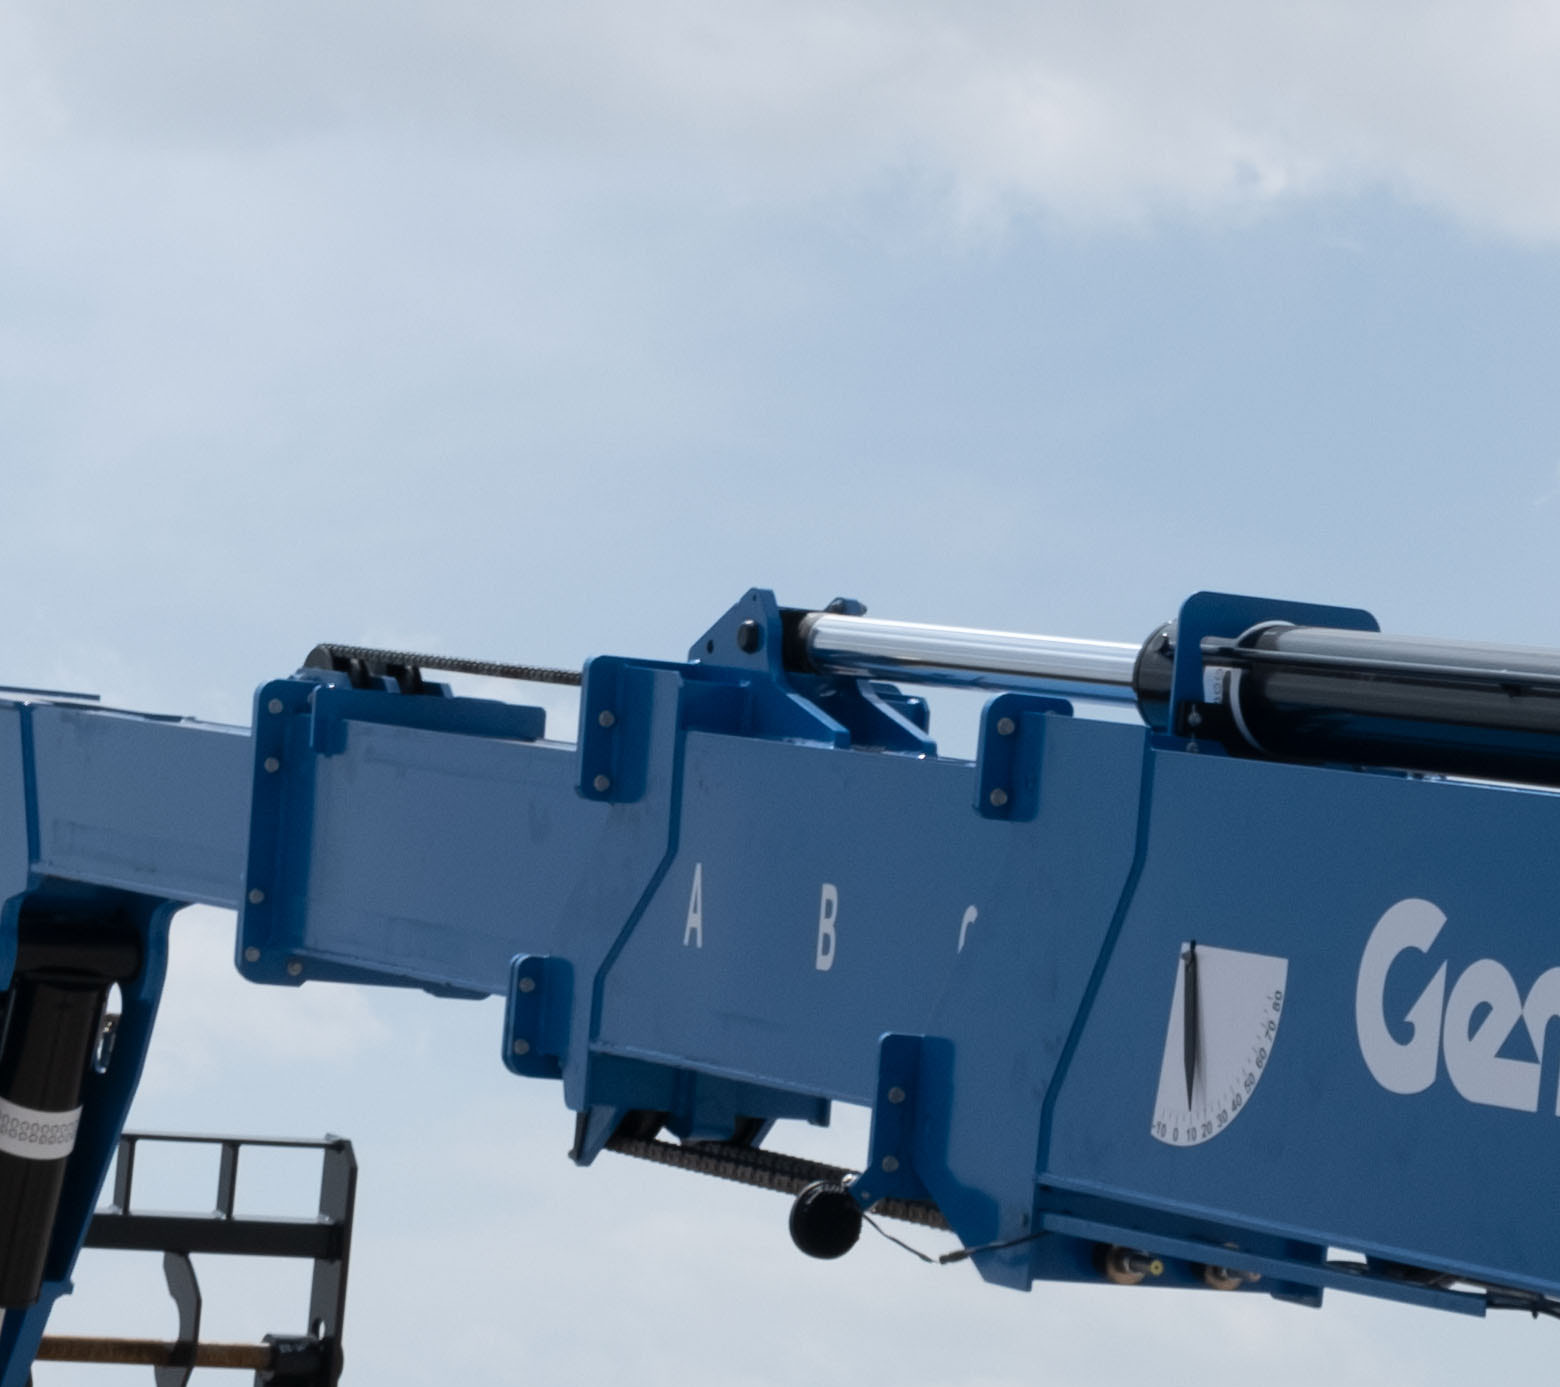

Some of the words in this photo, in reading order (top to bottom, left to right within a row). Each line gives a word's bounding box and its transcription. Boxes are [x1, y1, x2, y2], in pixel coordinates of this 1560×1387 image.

[683, 862, 702, 949] A
[816, 882, 838, 972] B
[1186, 1127, 1198, 1142] 10
[1201, 1121, 1213, 1138] 20
[1216, 1109, 1229, 1128] 30
